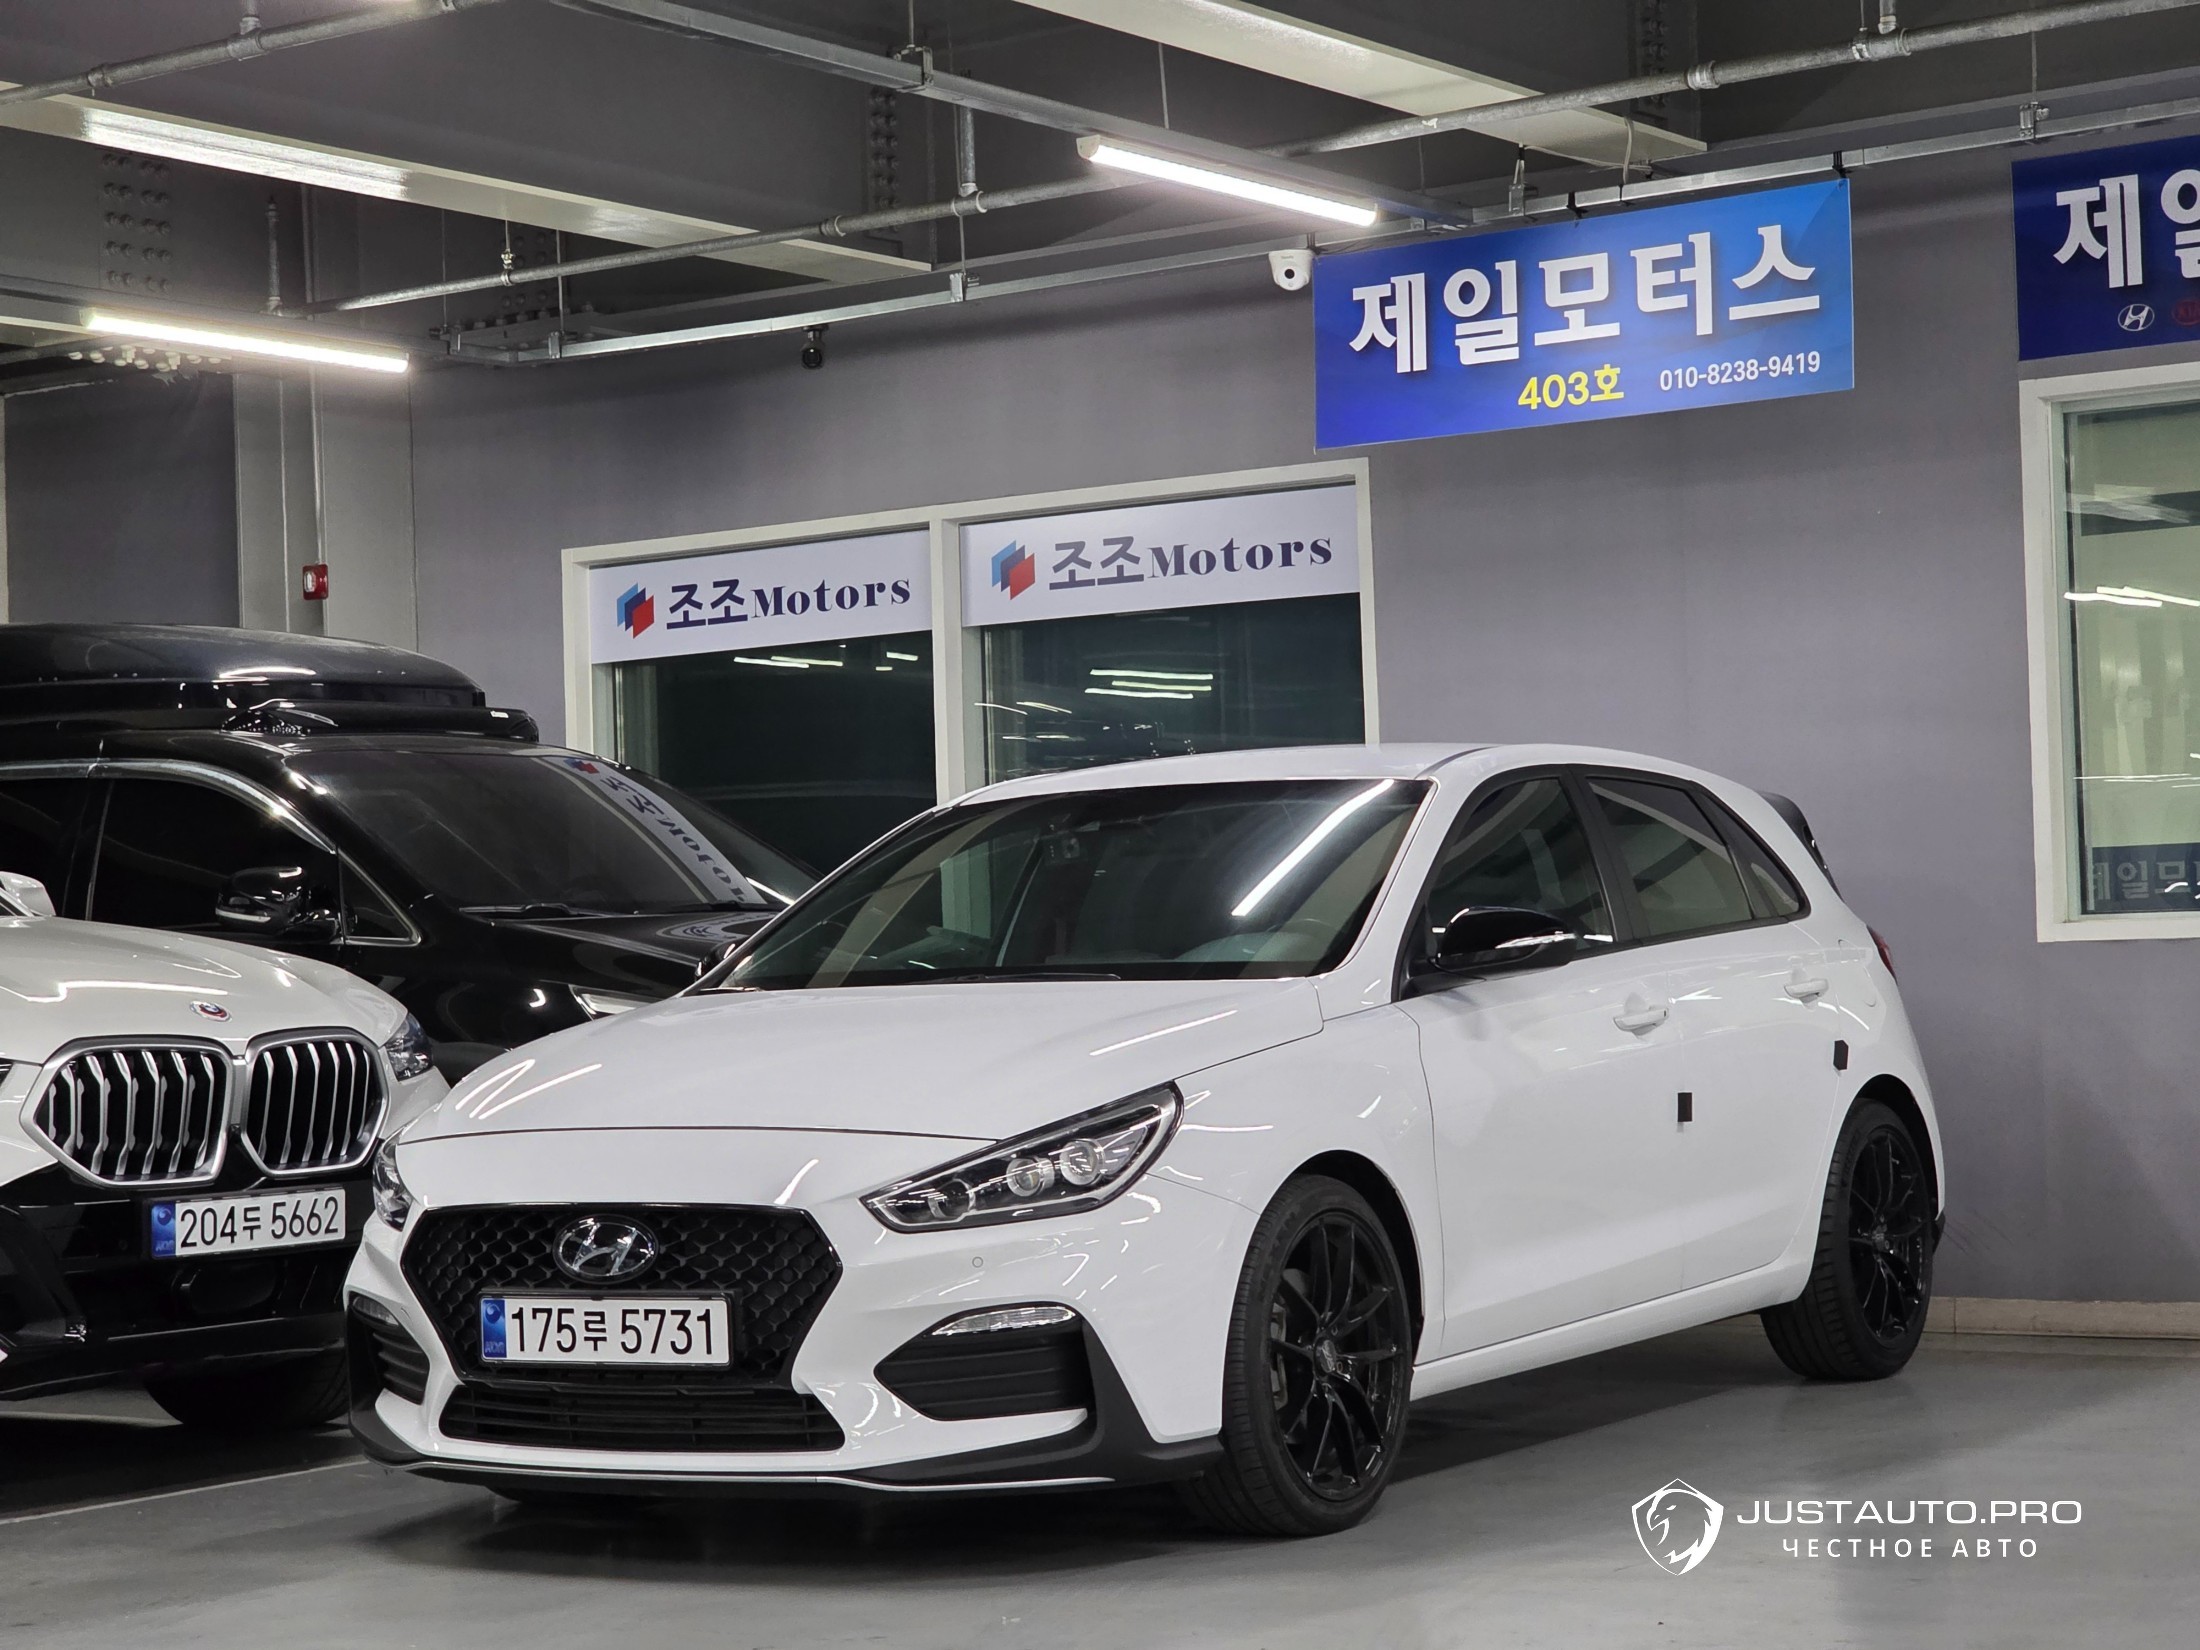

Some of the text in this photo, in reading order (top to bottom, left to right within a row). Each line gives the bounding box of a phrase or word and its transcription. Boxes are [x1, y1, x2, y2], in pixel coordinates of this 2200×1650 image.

[1349, 224, 1820, 373] 제일모터스
[1518, 364, 1624, 410] 403호
[1660, 351, 1820, 391] 010-8238-9419
[1050, 537, 1332, 591] 조조Motors
[667, 578, 910, 630] 조조Motors
[180, 1197, 339, 1248] 204두 5662
[511, 1307, 712, 1355] 175루 5731
